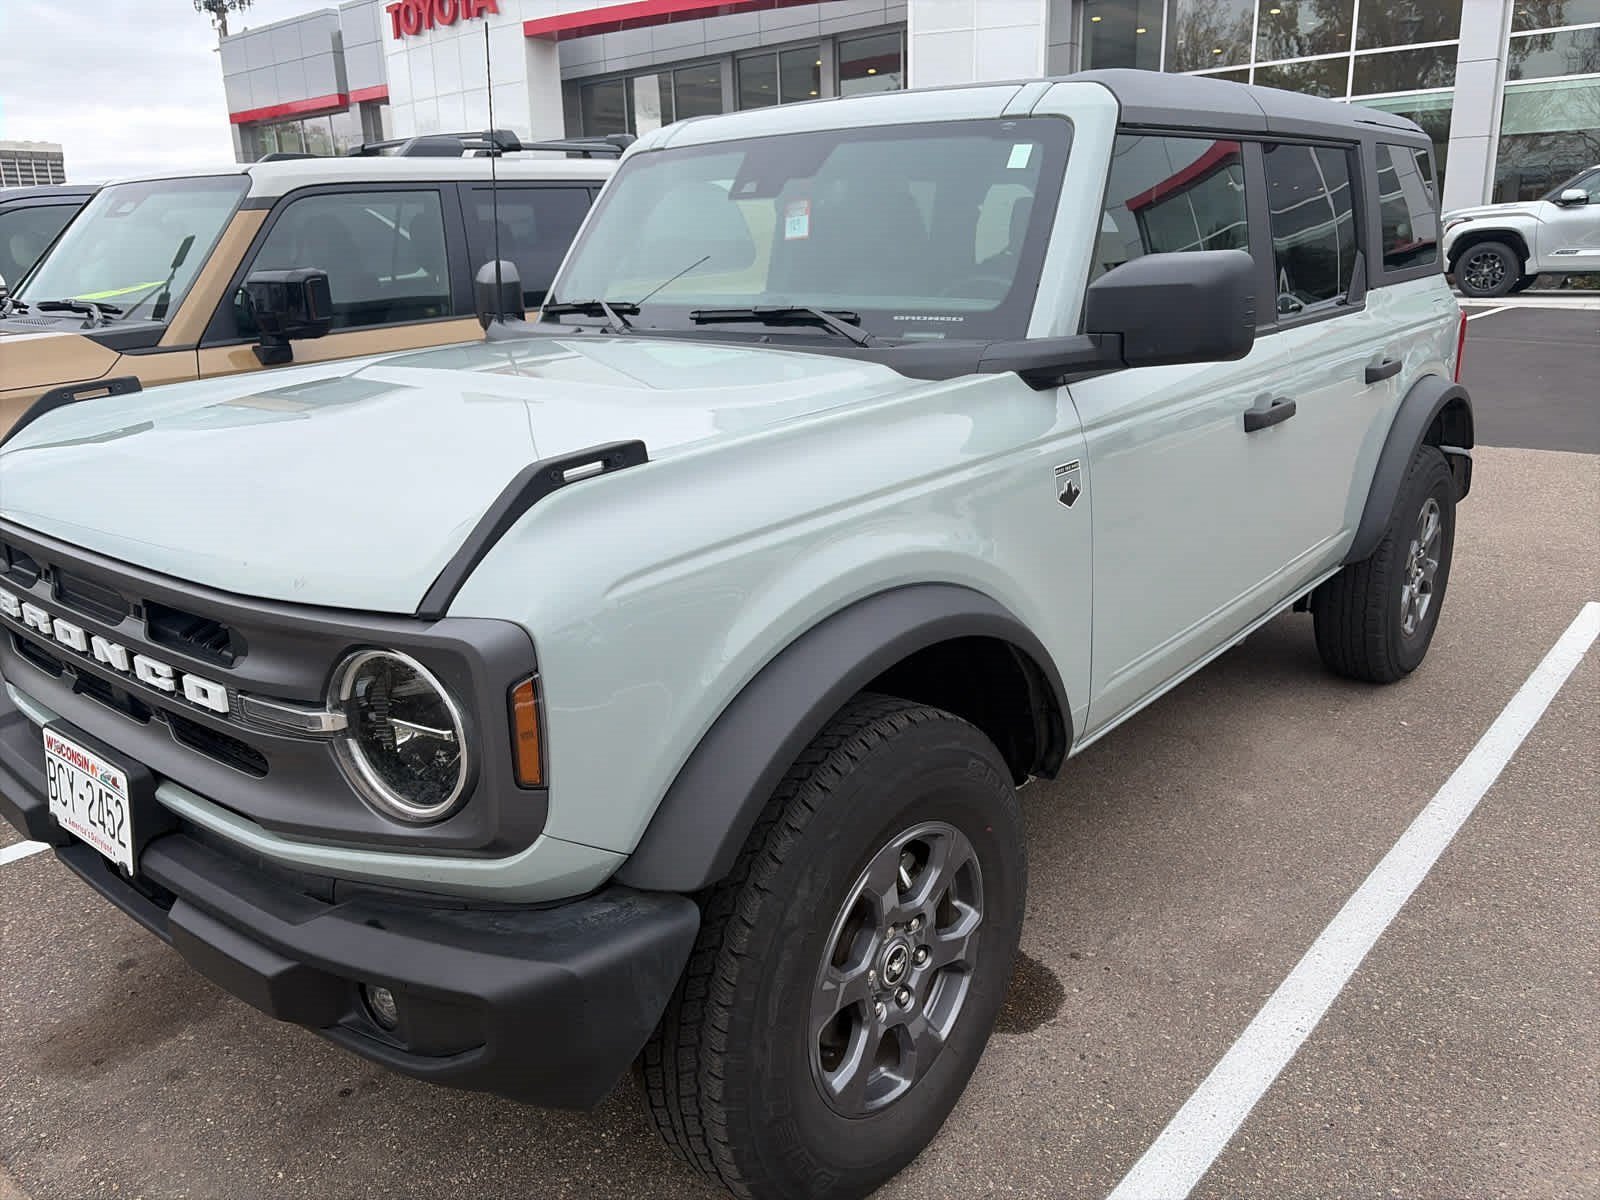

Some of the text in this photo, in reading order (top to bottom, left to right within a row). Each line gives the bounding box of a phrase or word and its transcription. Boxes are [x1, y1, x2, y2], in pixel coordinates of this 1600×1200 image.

[386, 0, 499, 40] TOYOTA
[0, 586, 230, 713] BRONCO
[46, 734, 90, 771] WISCONSIN
[47, 757, 126, 848] BCY-2452
